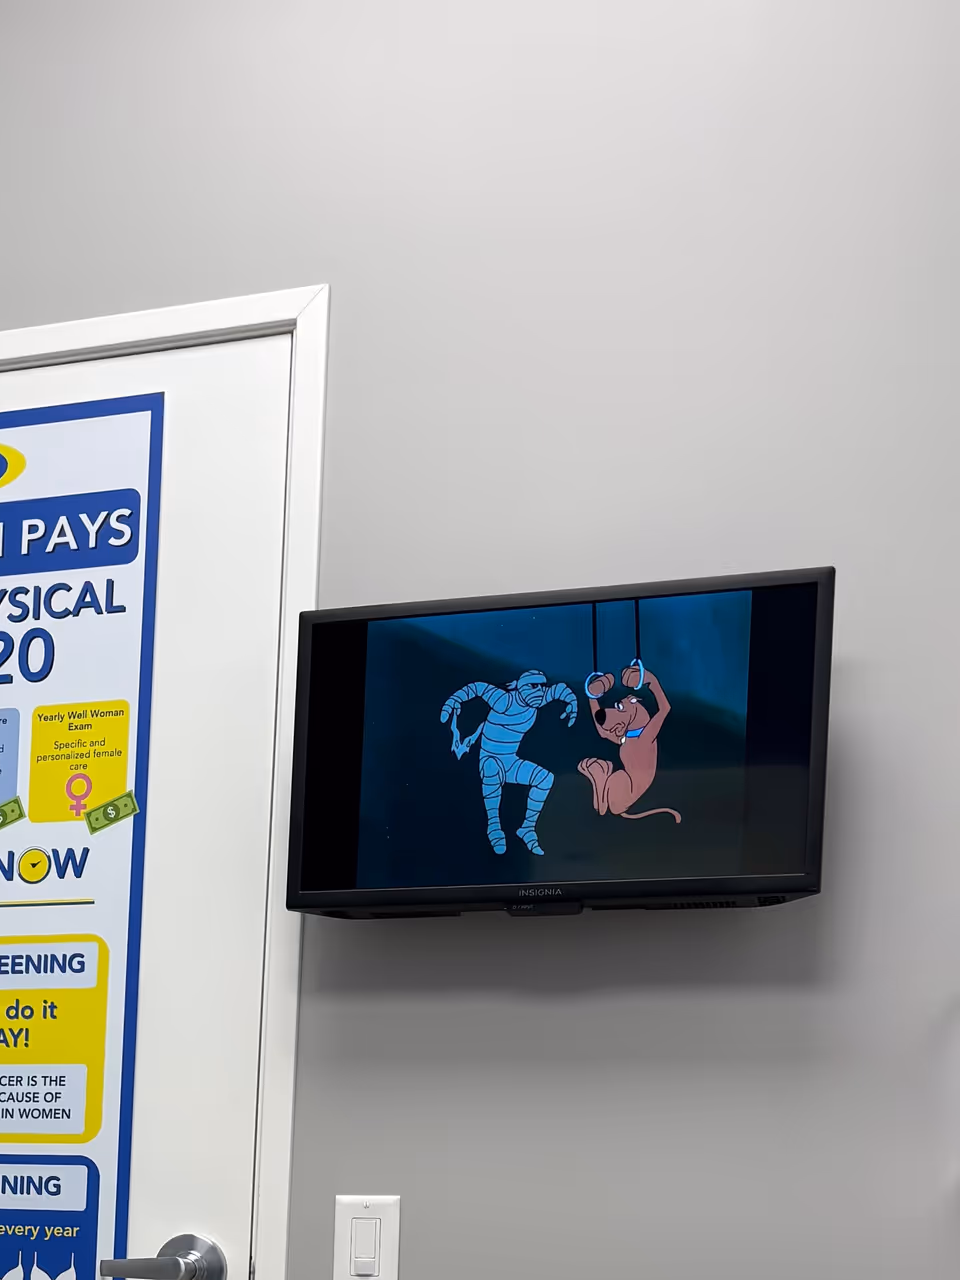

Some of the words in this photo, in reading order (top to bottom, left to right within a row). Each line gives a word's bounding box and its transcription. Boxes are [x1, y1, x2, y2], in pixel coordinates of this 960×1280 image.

[21, 509, 133, 554] PAYS
[38, 713, 65, 722] Yearly
[68, 711, 87, 720] Well
[90, 709, 124, 718] Woman
[68, 723, 92, 731] Exam
[54, 740, 87, 750] Specific
[90, 738, 105, 746] and
[36, 752, 90, 763] personalized
[93, 750, 122, 758] female
[5, 999, 34, 1019] do
[42, 1000, 58, 1019] it
[27, 1075, 38, 1087] IS
[42, 1075, 66, 1087] THE
[43, 1092, 62, 1103] OF
[1, 1107, 15, 1119] IN
[19, 1107, 71, 1119] WOMEN
[44, 1225, 80, 1241] year
